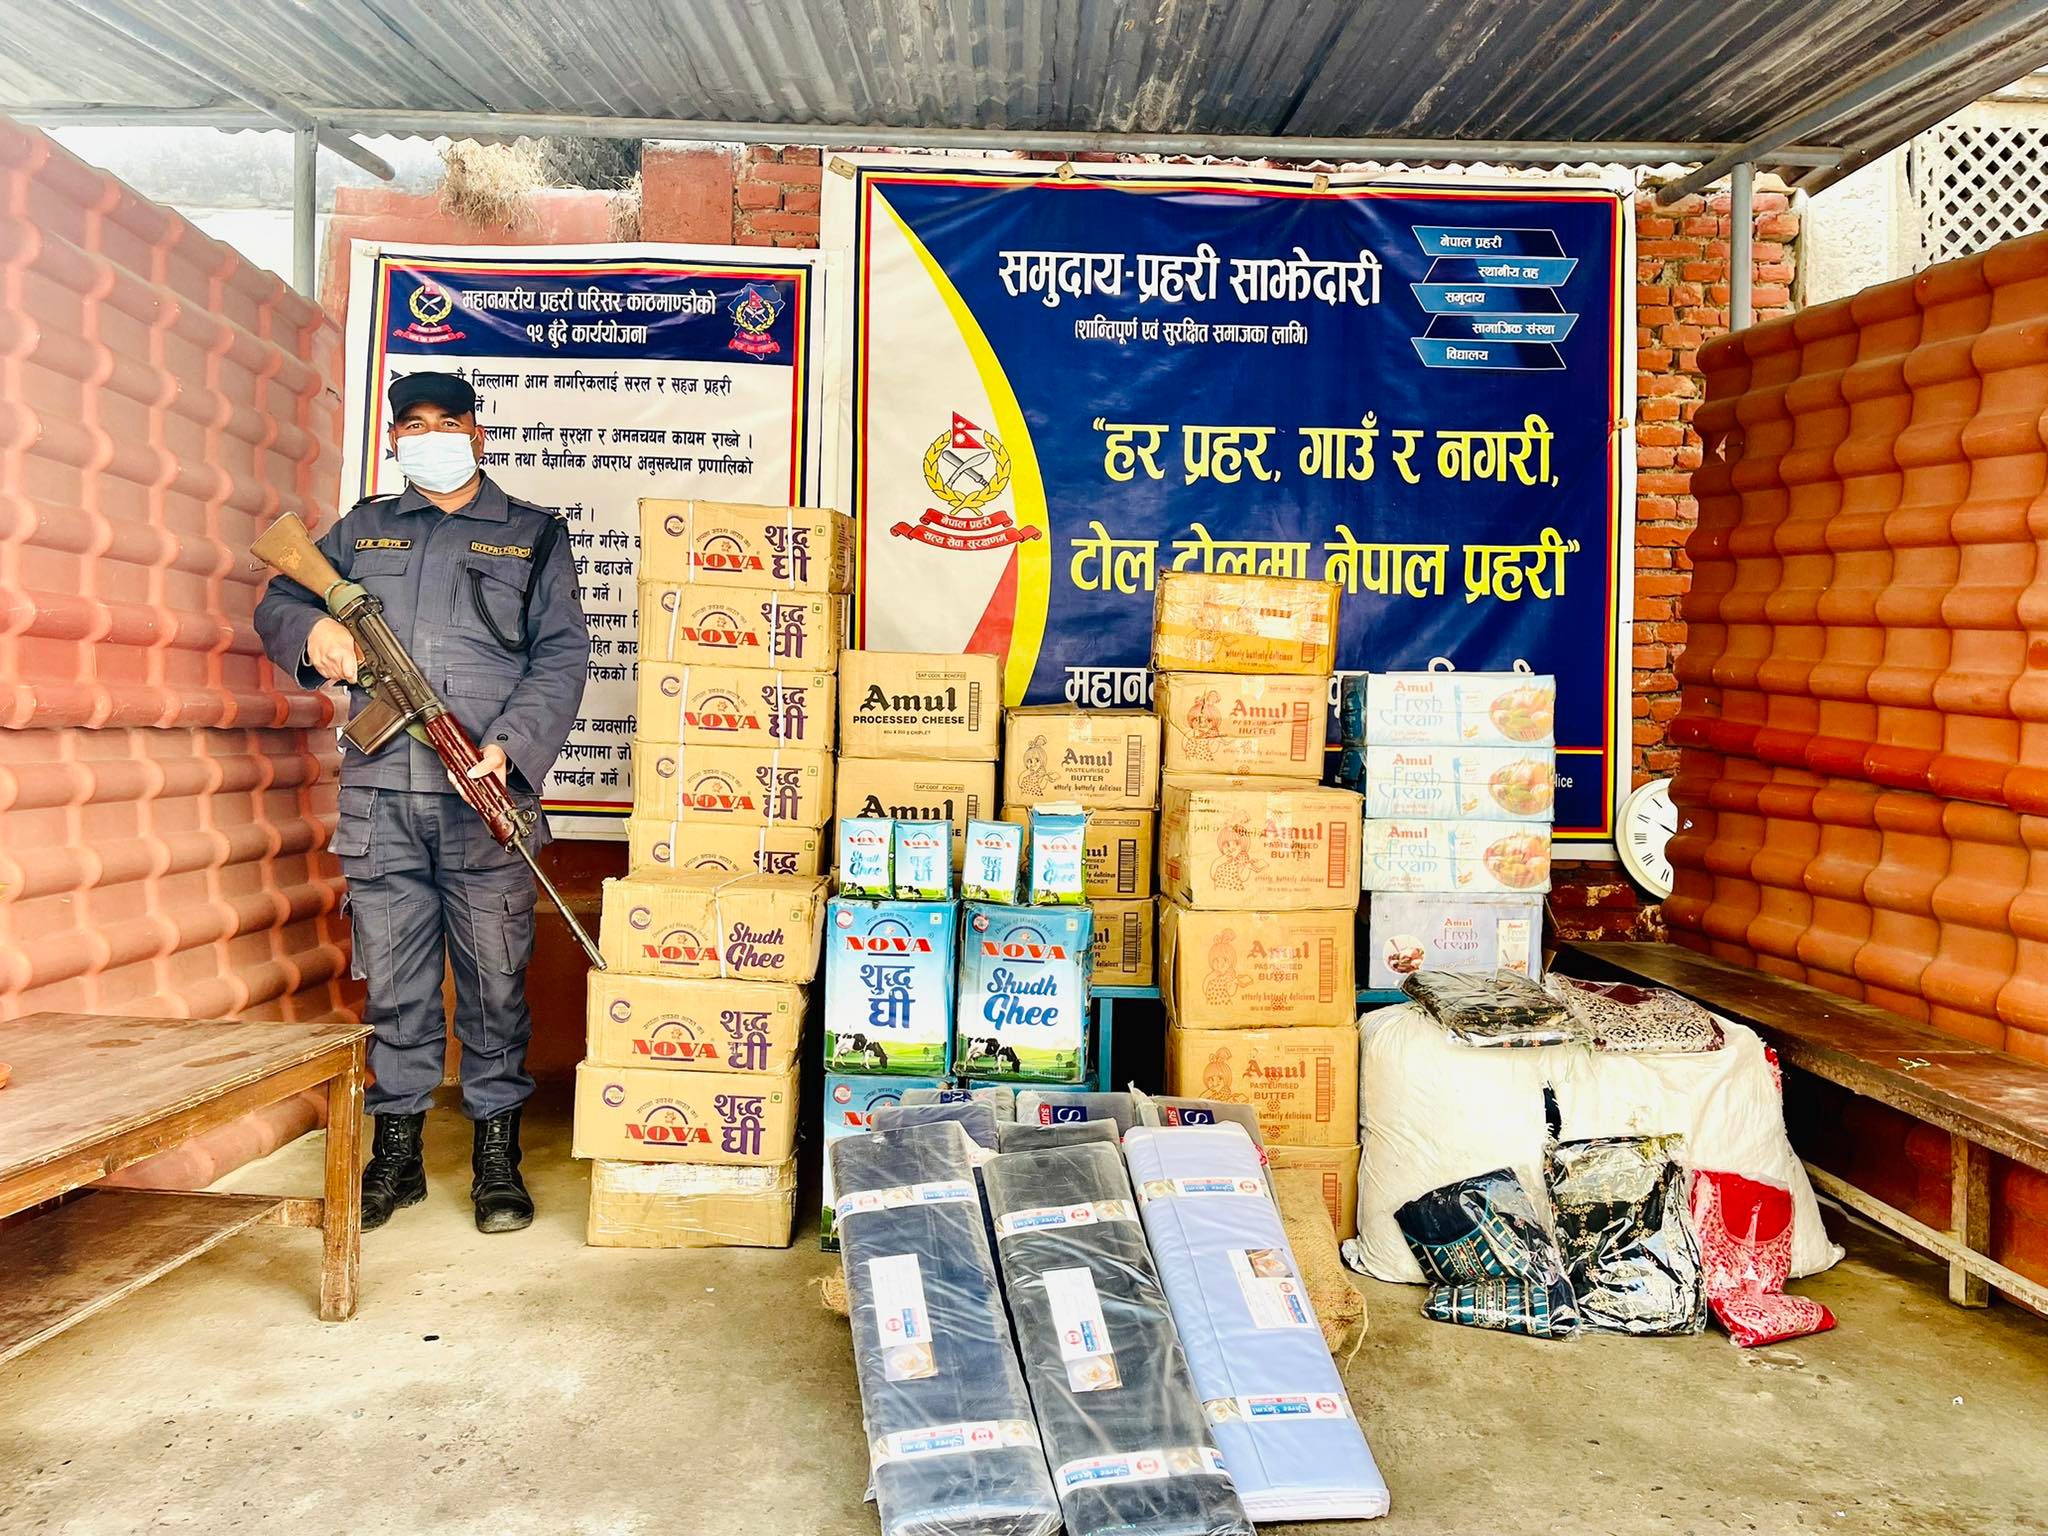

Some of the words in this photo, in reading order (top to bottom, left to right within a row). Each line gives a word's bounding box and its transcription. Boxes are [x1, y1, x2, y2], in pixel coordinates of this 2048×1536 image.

[1440, 234, 1472, 249] नेपाल
[1475, 235, 1503, 249] प्रहरी
[1478, 264, 1521, 279] स्थानीय
[1522, 267, 1540, 280] तह
[462, 287, 536, 311] महानगरीय
[539, 287, 574, 312] प्रहरी
[577, 286, 623, 313] परिसर
[627, 289, 717, 314] काठमाण्डौको
[1445, 292, 1486, 306] समुदाय
[526, 325, 543, 342] १२
[572, 319, 647, 344] कार्ययोजना
[1074, 314, 1137, 345] (शान्तिपूर्ण
[1141, 318, 1159, 341] एवं
[1162, 317, 1209, 345] सुरक्षित
[1211, 322, 1270, 345] समाजका
[1271, 320, 1309, 346] लागि)
[1471, 320, 1523, 335] सामाजिक
[1525, 322, 1556, 336] संस्था
[1446, 346, 1489, 361] विद्यालय
[472, 369, 519, 389] जिल्लामा
[525, 374, 548, 389] आम
[554, 369, 618, 392] नागरिकलाई
[624, 376, 651, 393] सरल
[657, 377, 666, 393] र
[671, 377, 698, 395] सहज
[703, 374, 732, 396] प्रहरी
[522, 421, 554, 443] शान्ति
[559, 427, 592, 448] सुरक्षा
[598, 428, 606, 445] र
[612, 428, 666, 445] अमनचयन
[672, 430, 705, 446] कायम
[712, 429, 739, 448] राख्ने
[1181, 425, 1282, 486] प्रहर,
[1299, 410, 1379, 482] गाउँ
[1392, 429, 1424, 484] र
[1436, 413, 1559, 488] नगरी,
[515, 452, 536, 467] तथा
[542, 447, 586, 470] वैज्ञानिक
[592, 454, 632, 472] अपराध
[638, 456, 692, 476] अनुसन्धान
[698, 455, 753, 476] प्रणालिको
[566, 502, 583, 521] गर्ने
[940, 513, 967, 529] नेपाल
[969, 515, 992, 530] प्रहरी
[600, 529, 629, 551] गरिने
[764, 525, 811, 553] शुद्ध
[923, 531, 944, 545] सत्य
[594, 557, 633, 576] बढाउने
[686, 551, 765, 571] NOVA
[772, 546, 812, 583] घी
[1070, 520, 1159, 594] टोल
[1324, 524, 1449, 598] नेपाल
[592, 583, 611, 601] गर्ने
[760, 602, 808, 630] शुद्ध
[681, 626, 760, 647] NOVA
[768, 622, 808, 659] घी
[1065, 666, 1154, 708] महान
[1393, 680, 1433, 693] Amul
[761, 685, 808, 712] शुद्ध
[859, 684, 958, 713] Amul
[1394, 693, 1442, 713] Fresh
[1229, 699, 1288, 719] Amul
[1380, 709, 1444, 726] Cream
[684, 711, 761, 730] NOVA
[768, 704, 808, 740] घी
[853, 715, 918, 724] PROCESSED
[922, 715, 965, 725] CHEESE
[1060, 748, 1113, 768] Amul
[1392, 754, 1433, 766] Amul
[601, 768, 619, 786] गर्ने
[755, 766, 803, 793] शुद्ध
[1393, 767, 1441, 786] Fresh
[677, 792, 755, 810] NOVA
[1378, 783, 1443, 801] Cream
[762, 785, 803, 820] घी
[856, 794, 955, 821] Amul
[1260, 820, 1323, 841] Amul
[1387, 826, 1428, 839] Amul
[1270, 851, 1311, 860] BUTTER
[1388, 839, 1438, 859] Fresh
[1373, 856, 1438, 873] Cream
[1444, 917, 1473, 927] Amul
[728, 921, 785, 946] Shudh
[1443, 927, 1479, 941] Fresh
[643, 944, 720, 962] NOVA
[845, 936, 932, 953] NOVA
[981, 941, 1068, 960] NOVA
[1246, 940, 1310, 960] Amul
[1433, 939, 1479, 951] Cream
[726, 942, 786, 972] Ghee
[860, 964, 915, 995] शुद्ध
[987, 967, 1058, 997] Shudh
[867, 987, 916, 1029] घी
[983, 994, 1059, 1031] Ghee
[720, 1010, 772, 1039] शुद्ध
[632, 1039, 720, 1059] NOVA
[727, 1031, 773, 1071] घी
[1242, 1059, 1306, 1079] Amul
[1250, 1082, 1299, 1090] PASTEURISED
[1254, 1091, 1295, 1100] BUTTER
[714, 1094, 766, 1124] शुद्ध
[1259, 1111, 1284, 1121] butterly
[1284, 1111, 1312, 1121] delicious
[624, 1123, 712, 1144] NOVA
[720, 1115, 766, 1156] घी
